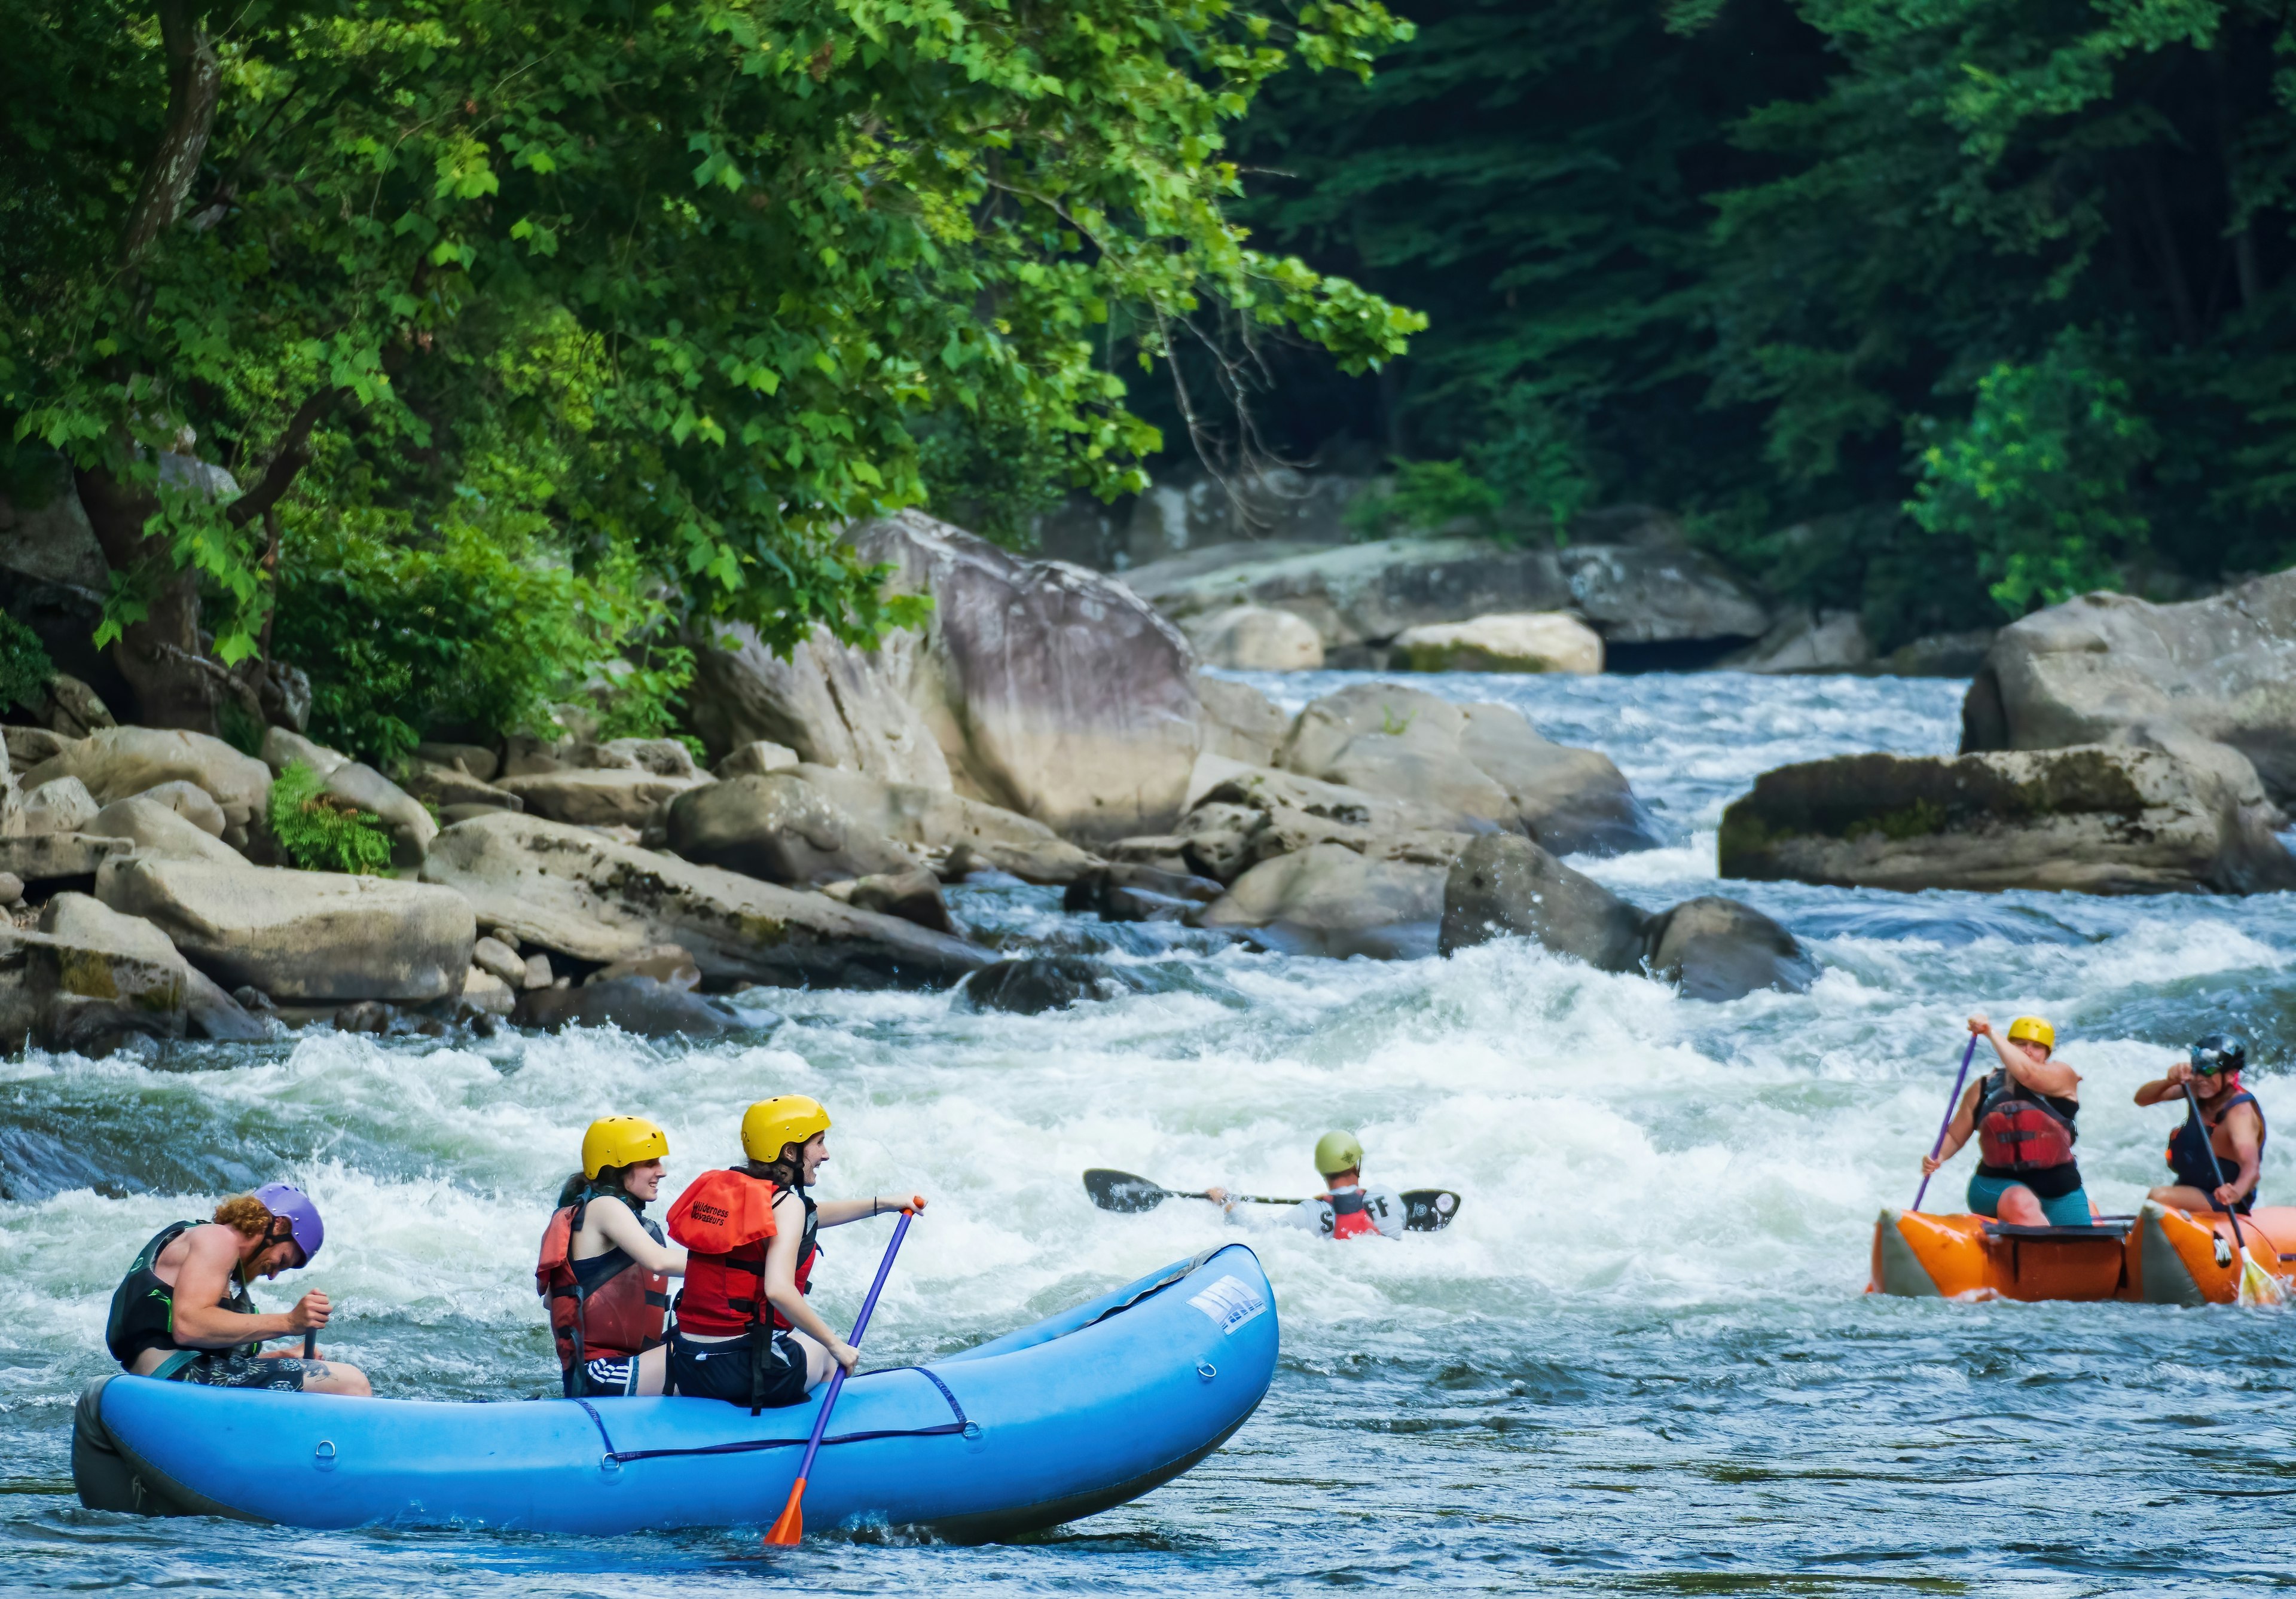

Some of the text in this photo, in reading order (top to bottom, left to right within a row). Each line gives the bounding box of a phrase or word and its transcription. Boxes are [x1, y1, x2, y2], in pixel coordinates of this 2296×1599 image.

[691, 1210, 725, 1226] Voyageurs
[693, 1200, 729, 1218] Wilderness
[1320, 1195, 1388, 1233] SFF
